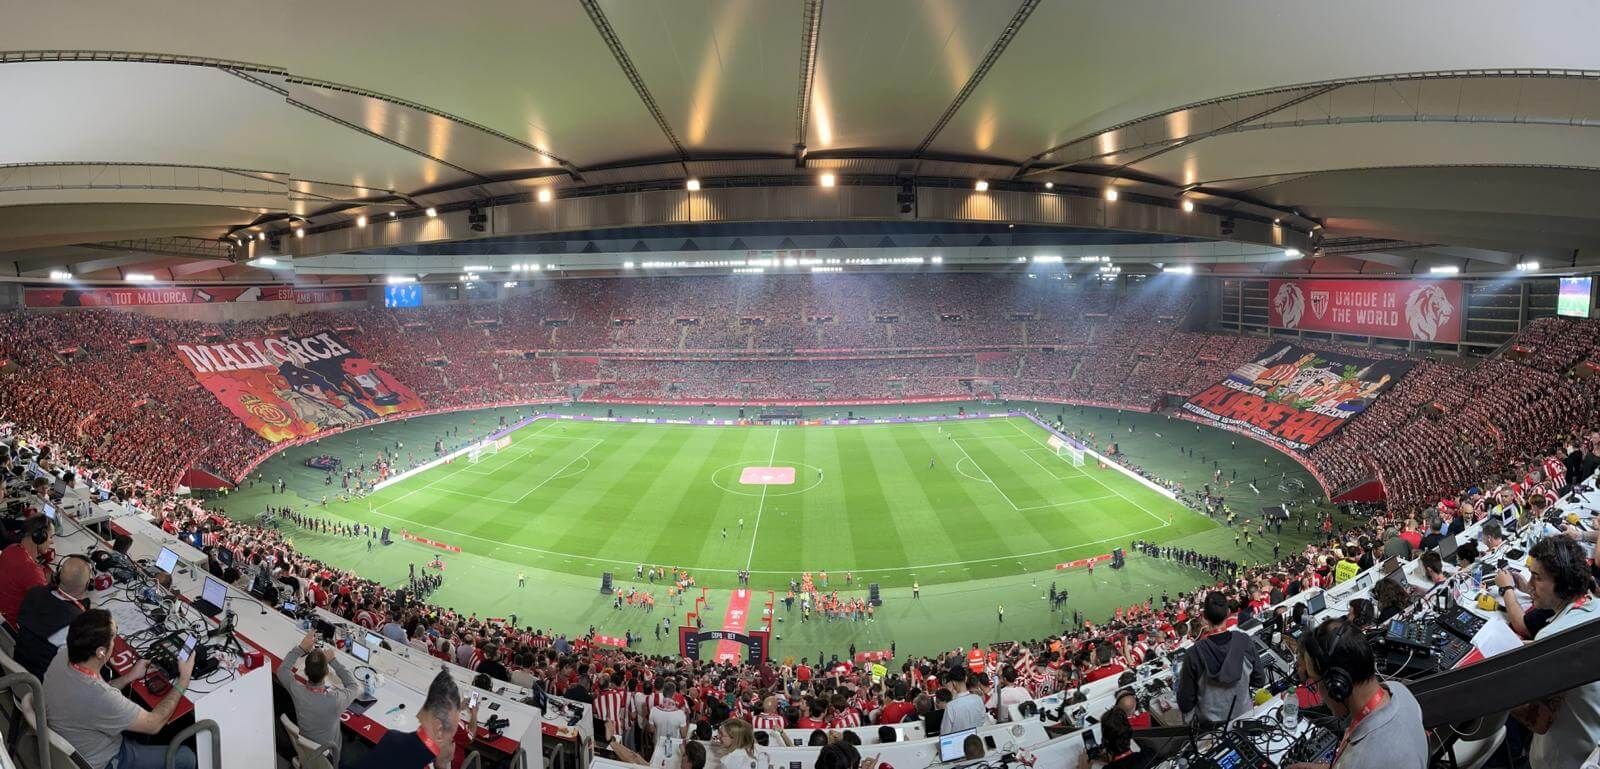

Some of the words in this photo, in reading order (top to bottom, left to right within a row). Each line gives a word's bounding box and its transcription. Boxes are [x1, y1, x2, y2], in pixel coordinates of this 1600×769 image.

[115, 292, 132, 304] TOT
[138, 292, 187, 304] MALLORCA
[1335, 291, 1378, 307] UNIQUE
[1383, 292, 1396, 308] IN
[1332, 308, 1351, 323] THE
[1356, 309, 1399, 326] WORLD
[177, 333, 350, 373] MALLORCA
